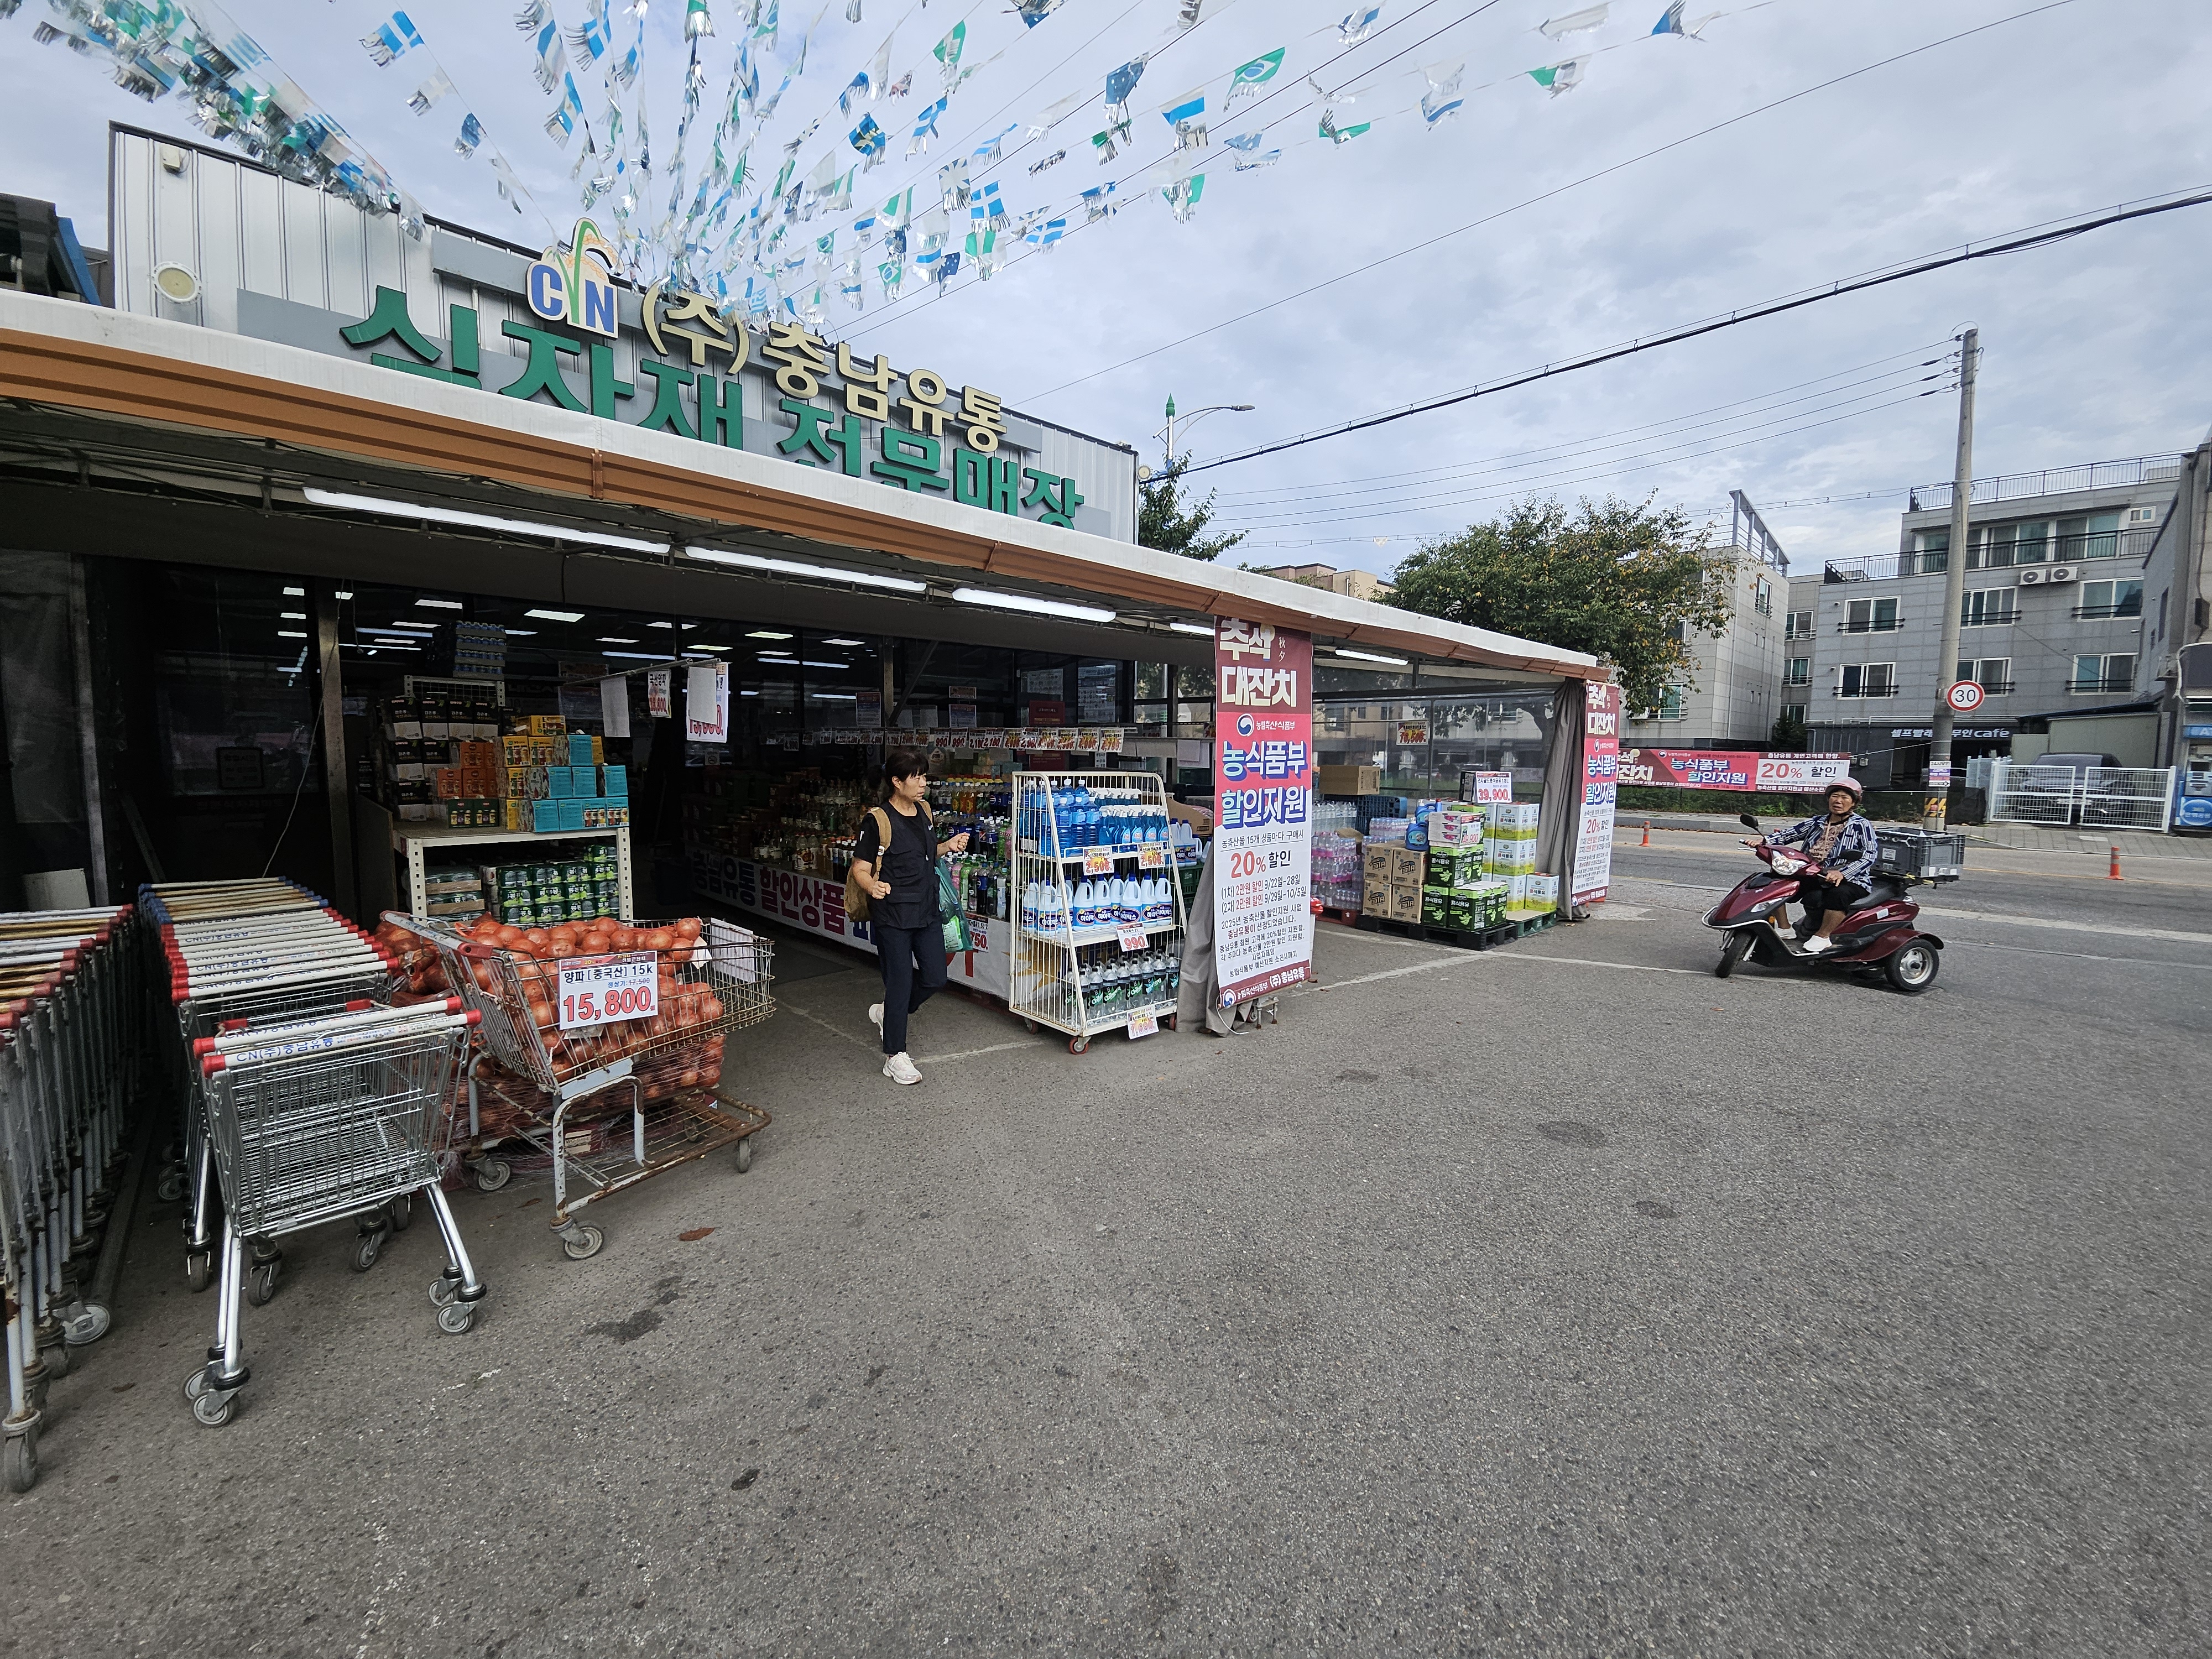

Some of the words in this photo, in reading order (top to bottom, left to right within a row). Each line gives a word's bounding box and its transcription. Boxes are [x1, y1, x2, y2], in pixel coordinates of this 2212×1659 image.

[1219, 618, 1274, 661] 추석
[1221, 666, 1297, 707] 대잔치
[1955, 689, 1976, 702] 30
[1256, 721, 1295, 731] 농림축산식품부
[1587, 712, 1615, 735] 대잔치
[1974, 728, 2010, 738] café
[1222, 740, 1306, 778] 농식품부
[1588, 754, 1616, 775] 농식품부
[1671, 758, 1729, 771] 농식품부
[1617, 764, 1653, 781] 잔치
[1687, 771, 1746, 785] 할인지원
[1761, 763, 1802, 778] 20%
[1811, 766, 1836, 778] 할인
[1585, 781, 1615, 803] 할인지원
[1221, 785, 1305, 826] 할인지원
[1586, 818, 1600, 834] 20%
[1601, 820, 1609, 830] 할인
[1222, 836, 1245, 849] 농축산물
[1247, 833, 1260, 844] 15개
[1261, 831, 1284, 843] 상품마다
[1286, 829, 1303, 841] 구매시
[1230, 851, 1266, 879] 20%
[1268, 850, 1291, 869] 할인
[693, 849, 757, 907] 충남유통
[760, 867, 847, 936] 할인상품
[1221, 885, 1234, 900] (1차)
[1235, 882, 1250, 896] 2만원
[1252, 880, 1263, 893] 할인
[1222, 900, 1235, 915] (2차)
[1236, 896, 1251, 910] 2만원
[1252, 894, 1263, 907] 할인
[1221, 916, 1241, 930] 2025년
[1243, 910, 1265, 924] 농축산물
[1266, 905, 1288, 919] 할인지원
[1290, 903, 1302, 912] 사업
[1228, 924, 1255, 940] 충남유통이
[1124, 936, 1145, 950] 990
[1240, 937, 1250, 947] 회원
[564, 970, 585, 983] 양파
[632, 964, 653, 975] 15k
[1237, 982, 1269, 999] 농림축산식품부
